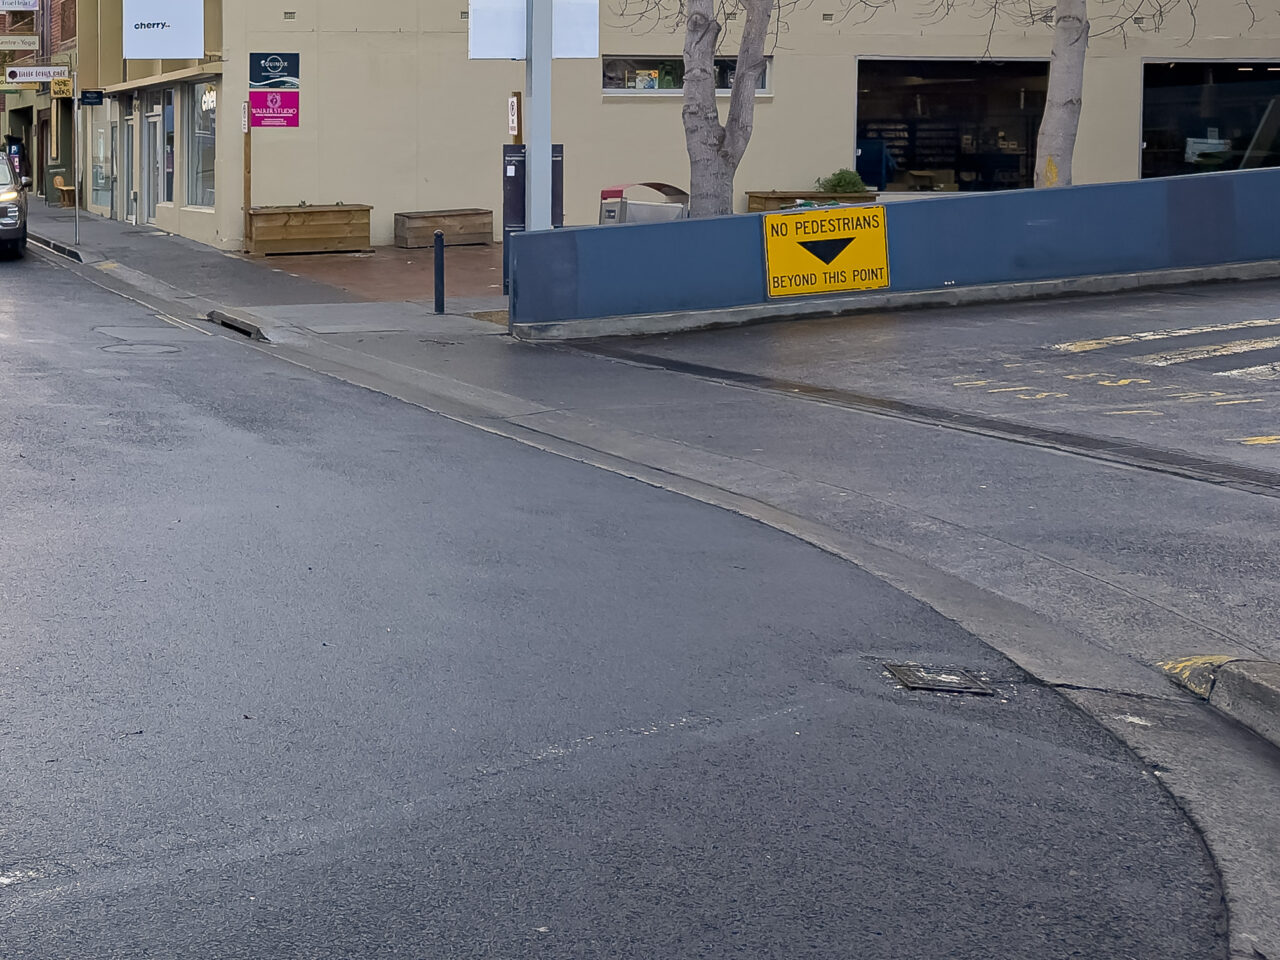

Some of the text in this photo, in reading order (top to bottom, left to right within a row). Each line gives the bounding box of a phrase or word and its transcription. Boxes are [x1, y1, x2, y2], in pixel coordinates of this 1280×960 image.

[11, 145, 18, 154] P
[771, 214, 879, 237] NO PEDESTRIANS
[772, 267, 885, 288] BEYOND THIS POINT
